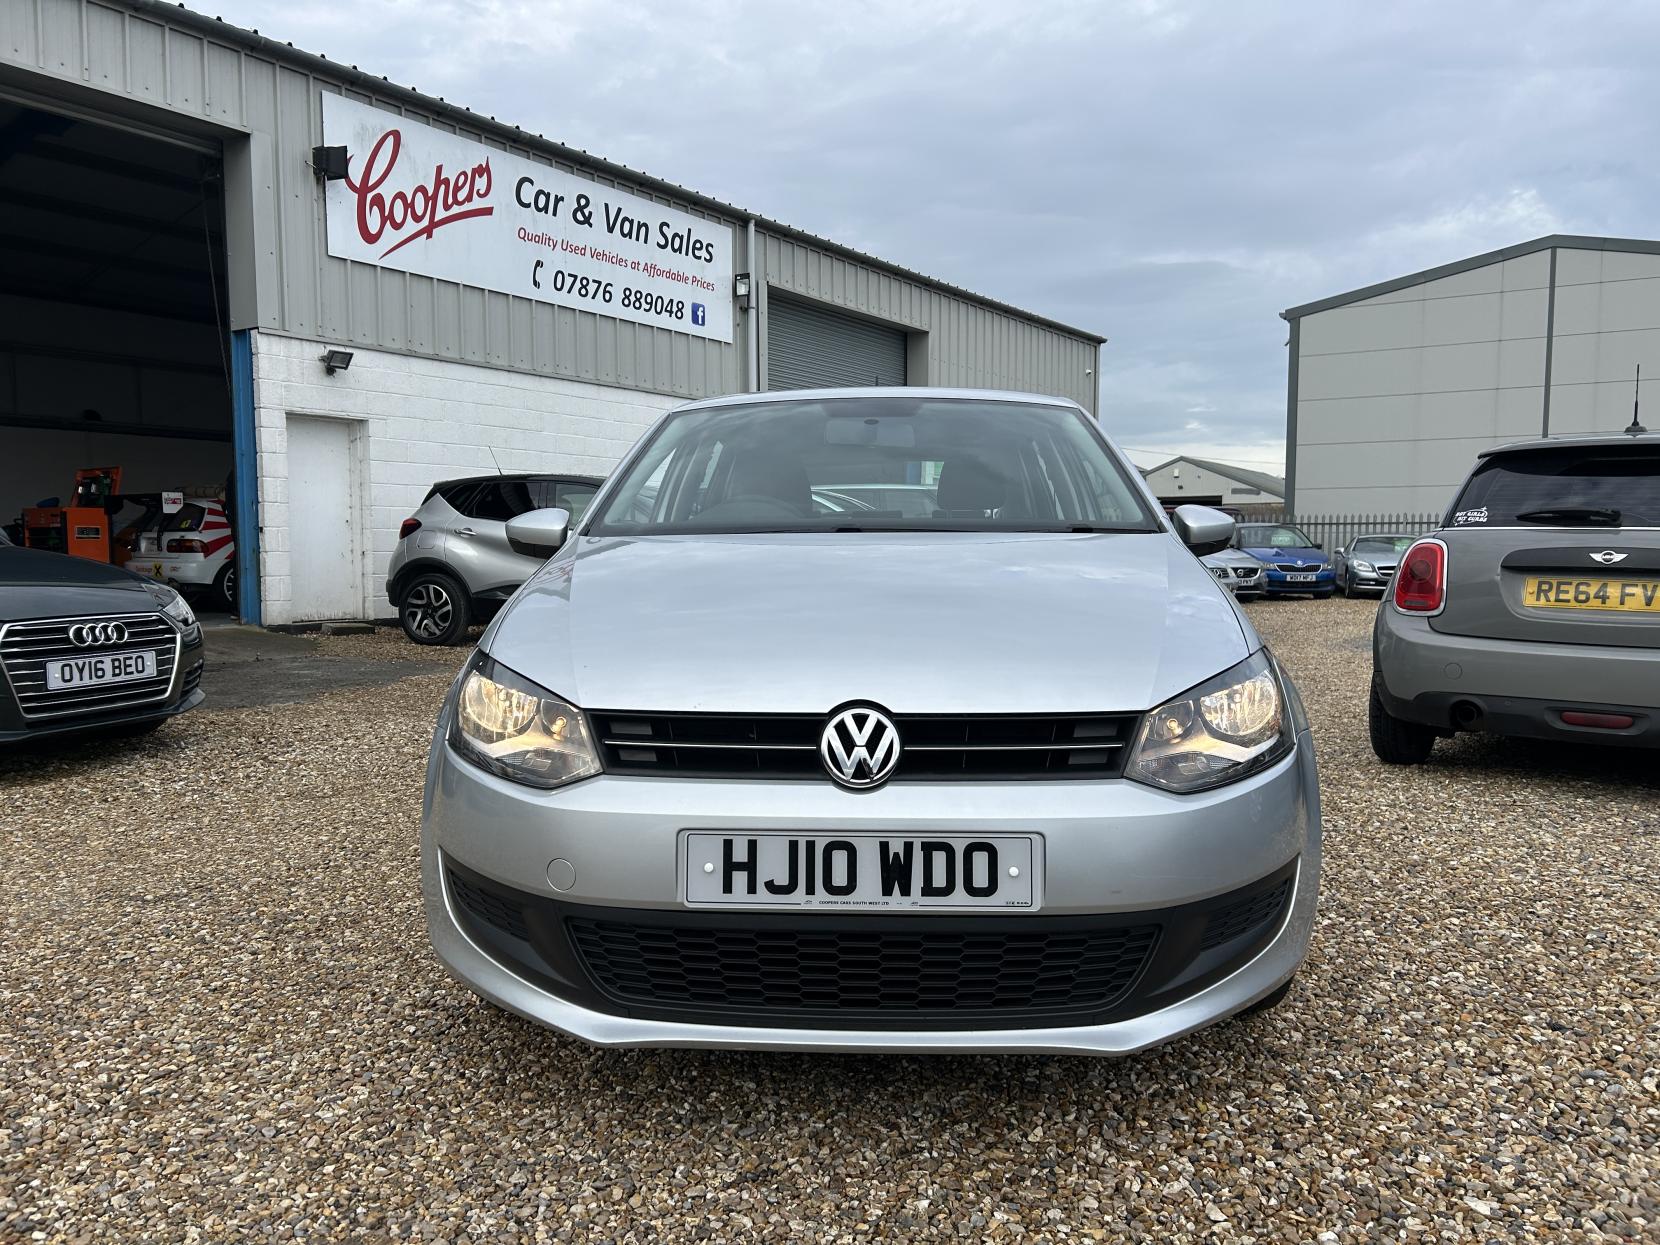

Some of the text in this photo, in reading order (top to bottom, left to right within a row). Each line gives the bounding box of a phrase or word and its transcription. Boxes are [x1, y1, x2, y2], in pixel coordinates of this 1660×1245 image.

[345, 129, 493, 250] Coopers
[515, 176, 714, 263] Car & Van Sales
[517, 227, 715, 291] Quality Used Vehicles at Affordable Prices
[553, 270, 685, 320] 07876 889048
[1536, 579, 1611, 605] RE64
[60, 655, 146, 683] OY16 BEO
[722, 838, 999, 897] HJ10 WDO
